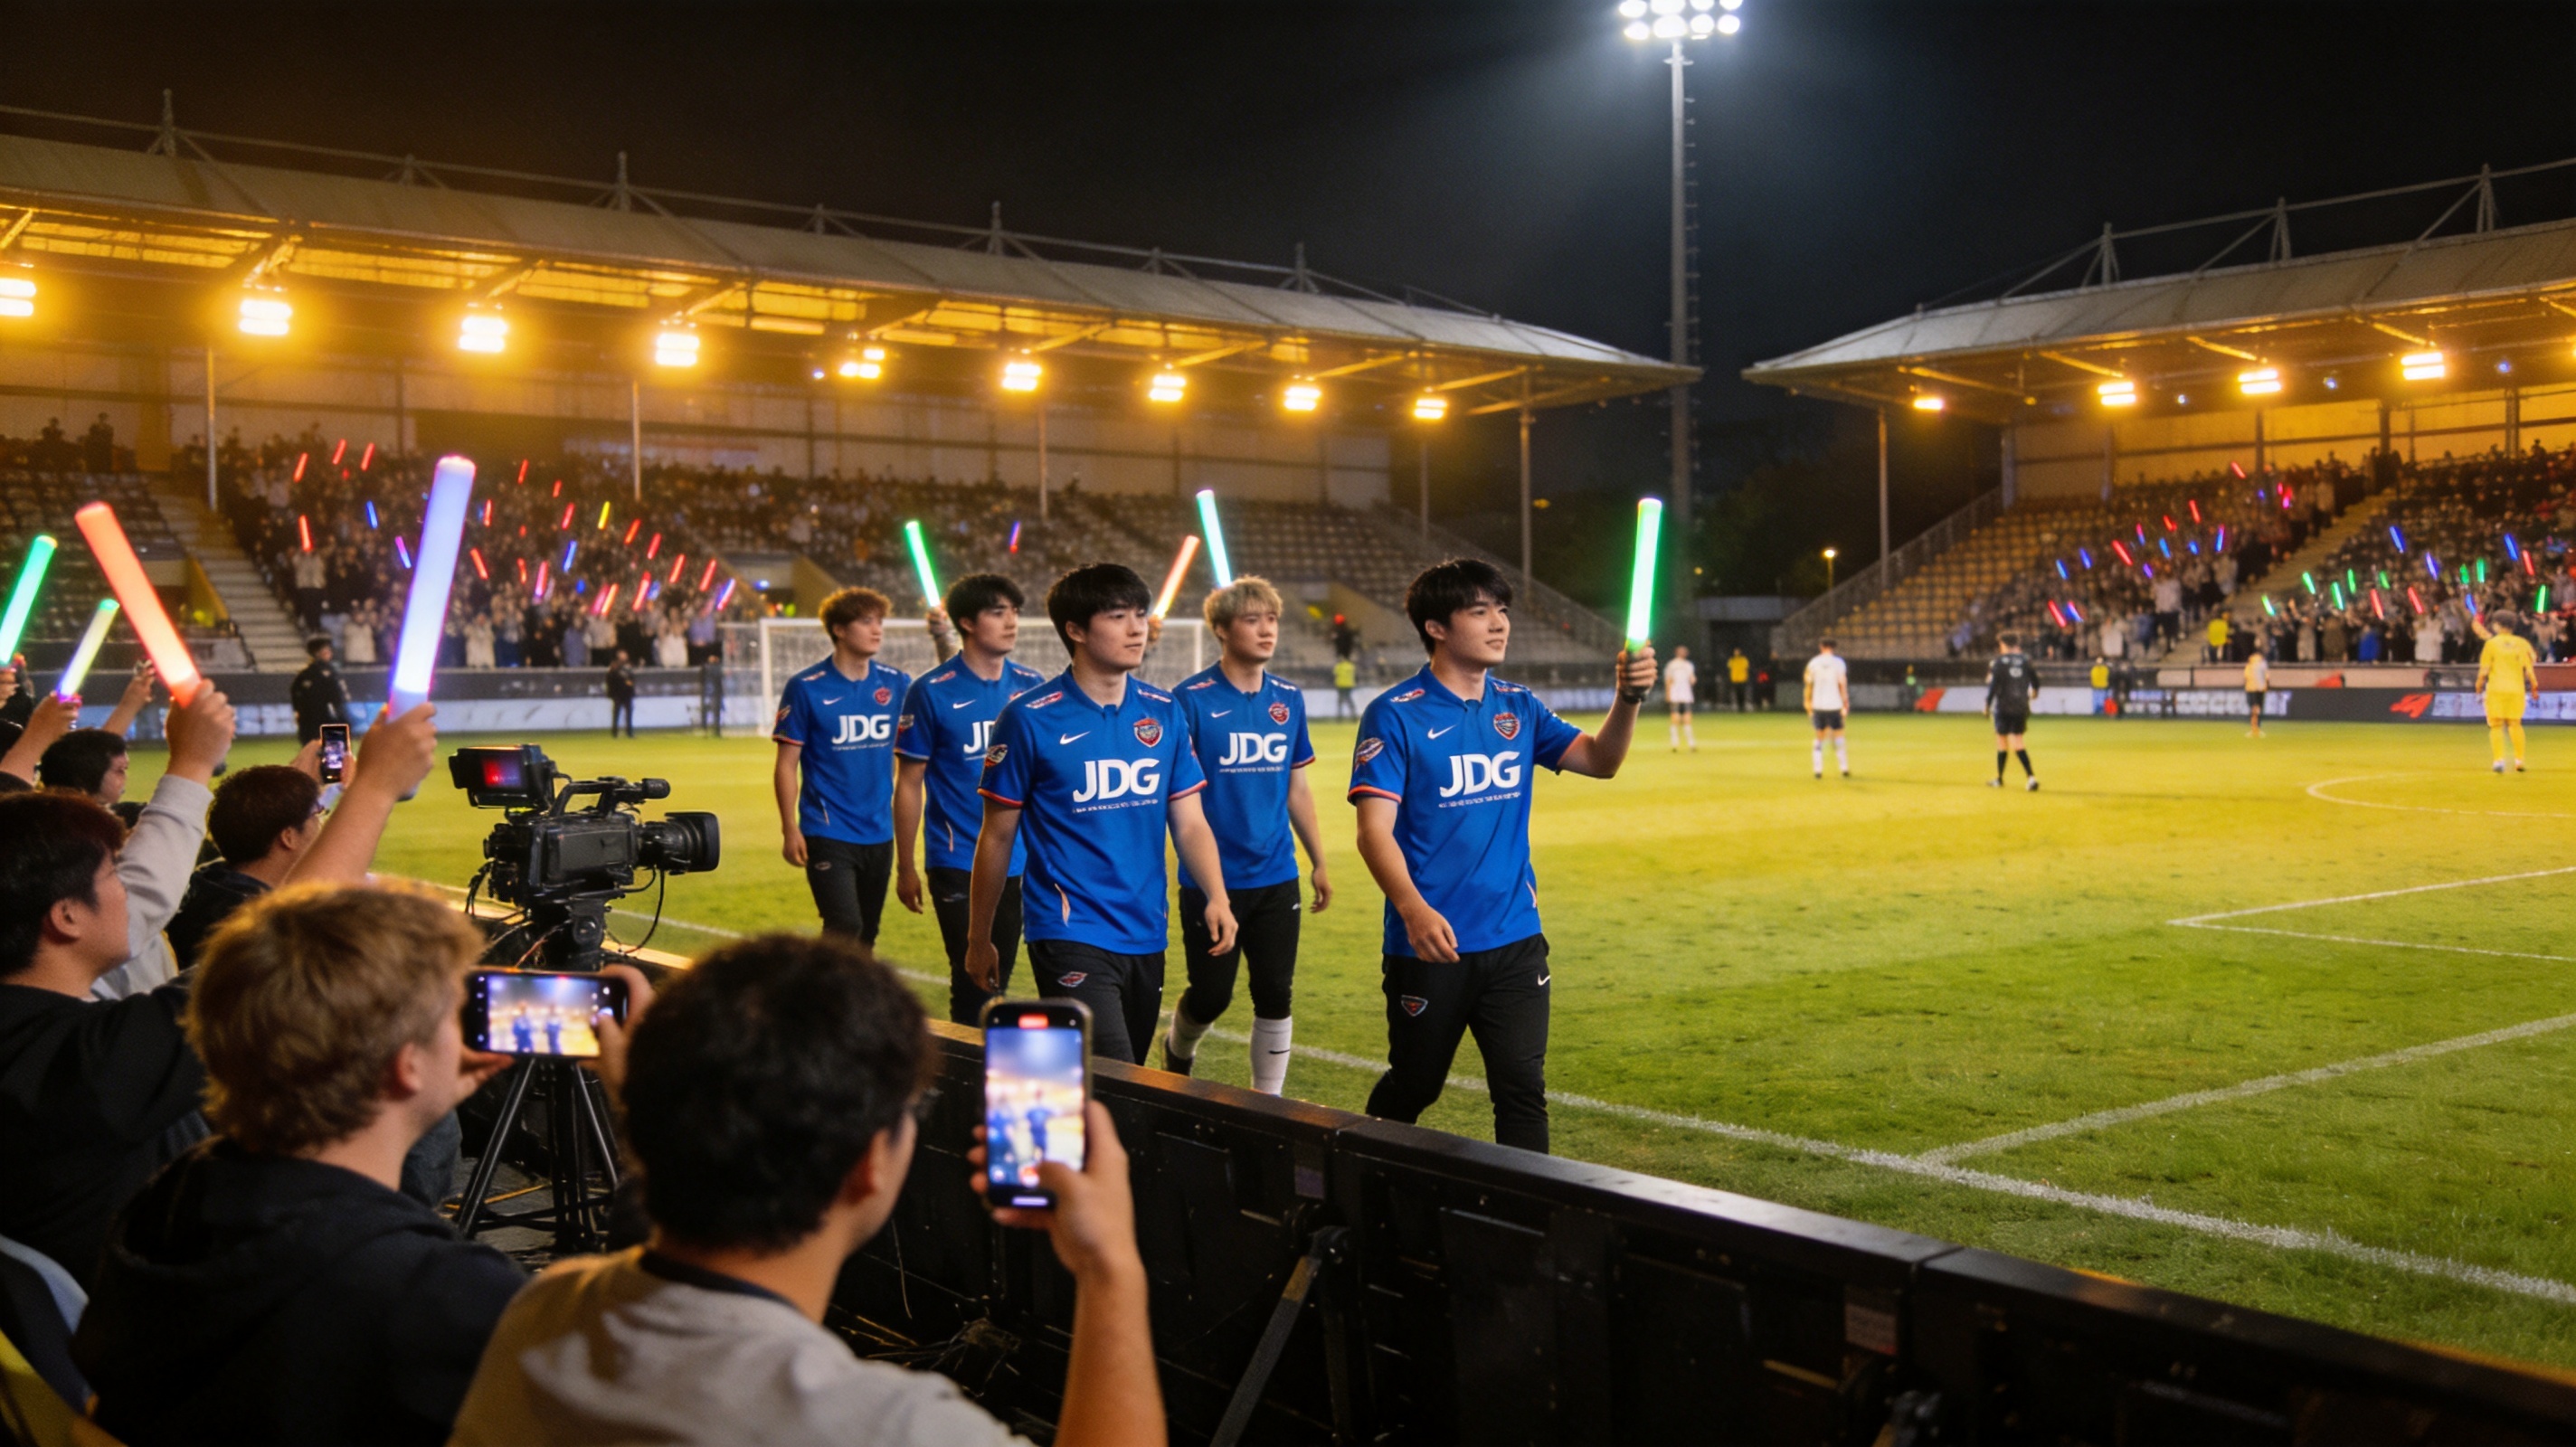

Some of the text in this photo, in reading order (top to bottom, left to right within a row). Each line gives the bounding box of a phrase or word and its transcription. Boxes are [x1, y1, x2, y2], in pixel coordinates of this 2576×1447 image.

[832, 714, 891, 744] JDG
[1219, 733, 1288, 766] JDG
[1073, 758, 1160, 803] JDG
[1439, 752, 1521, 798] JDG
